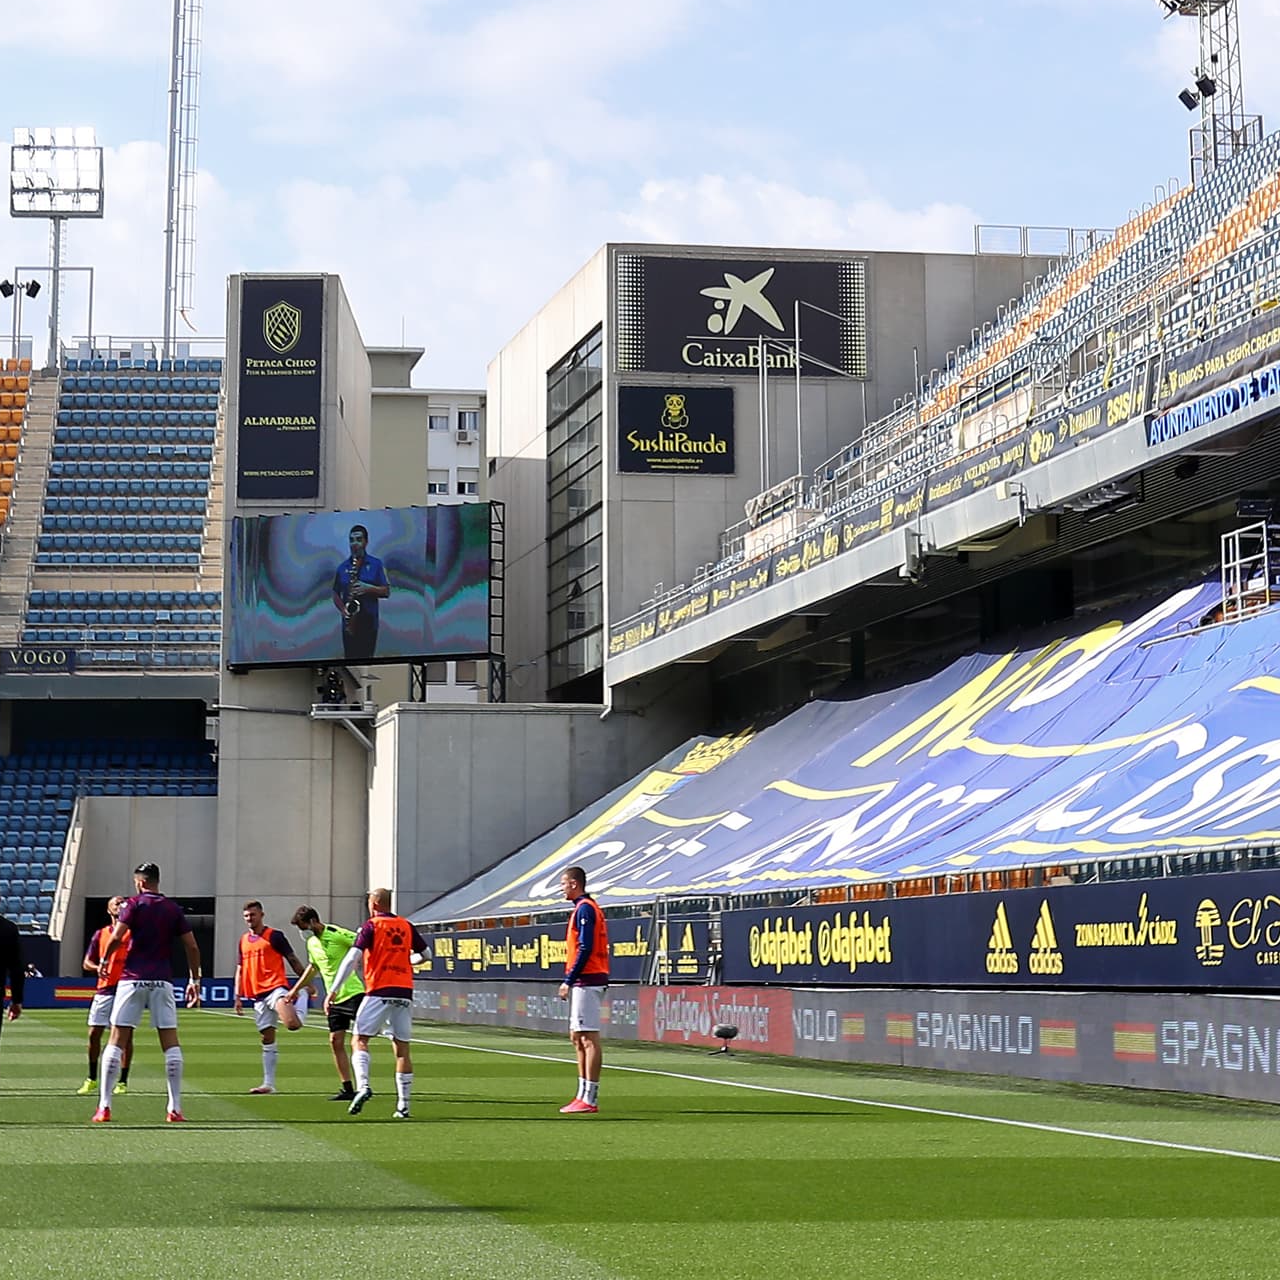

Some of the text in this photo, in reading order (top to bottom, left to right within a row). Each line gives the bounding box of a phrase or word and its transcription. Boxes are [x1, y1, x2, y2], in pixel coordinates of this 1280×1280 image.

[246, 358, 316, 368] PETACA CHICO
[682, 342, 802, 370] CaixaBank
[1204, 354, 1225, 376] PARA
[244, 416, 316, 426] ALMADRABA
[1149, 387, 1234, 447] AYUNTAMIENTO
[1239, 381, 1257, 408] DE
[626, 430, 727, 454] SushiPanda
[10, 650, 67, 664] VOGO
[1228, 898, 1261, 950] El
[760, 910, 891, 974] dafabet dafabet
[986, 949, 1019, 974] adidas
[1029, 949, 1063, 975] adidas
[917, 1012, 1033, 1055] SPAGNOLO
